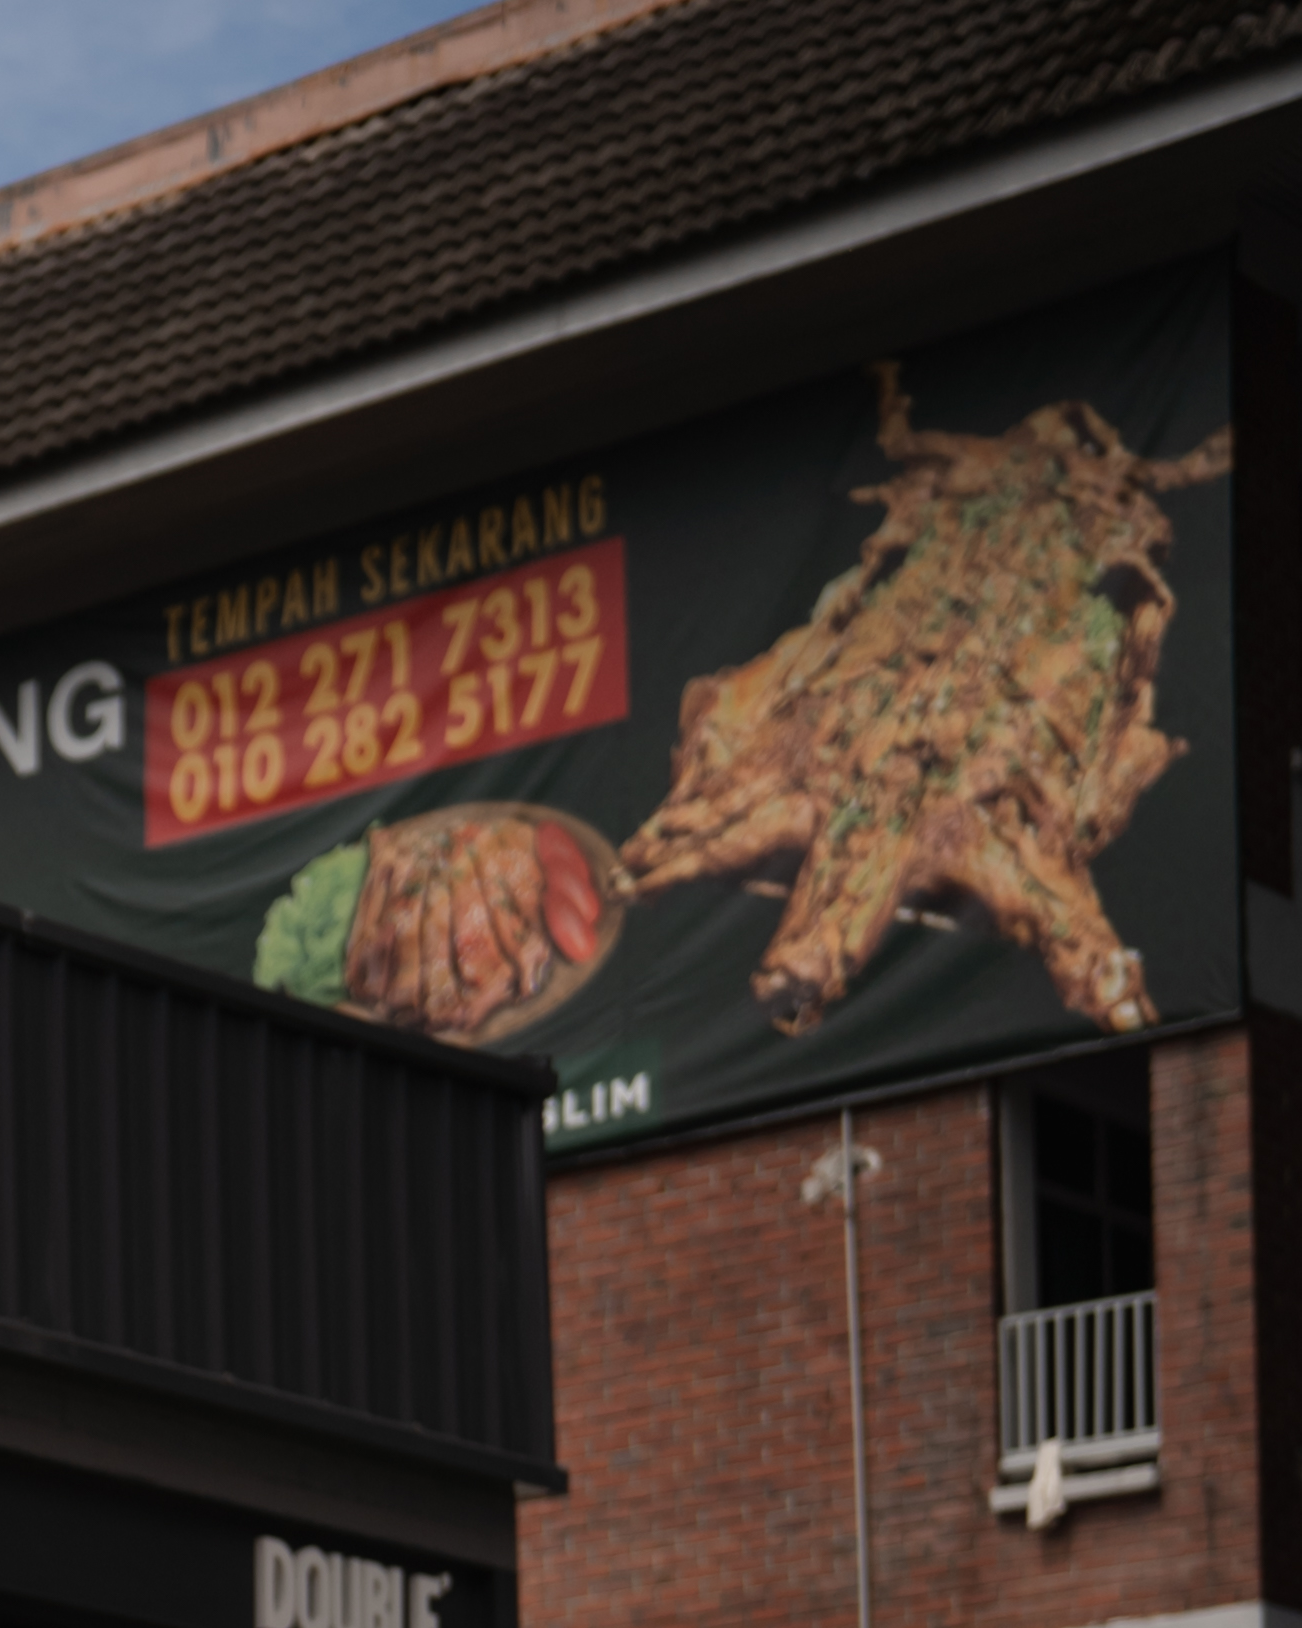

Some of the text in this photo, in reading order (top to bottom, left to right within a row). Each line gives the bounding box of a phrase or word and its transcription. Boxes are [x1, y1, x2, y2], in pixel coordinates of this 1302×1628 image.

[162, 472, 606, 663] TEMPAH SEKARANG
[170, 564, 599, 751] 012 271 7313
[169, 635, 603, 822] 010 282 5177
